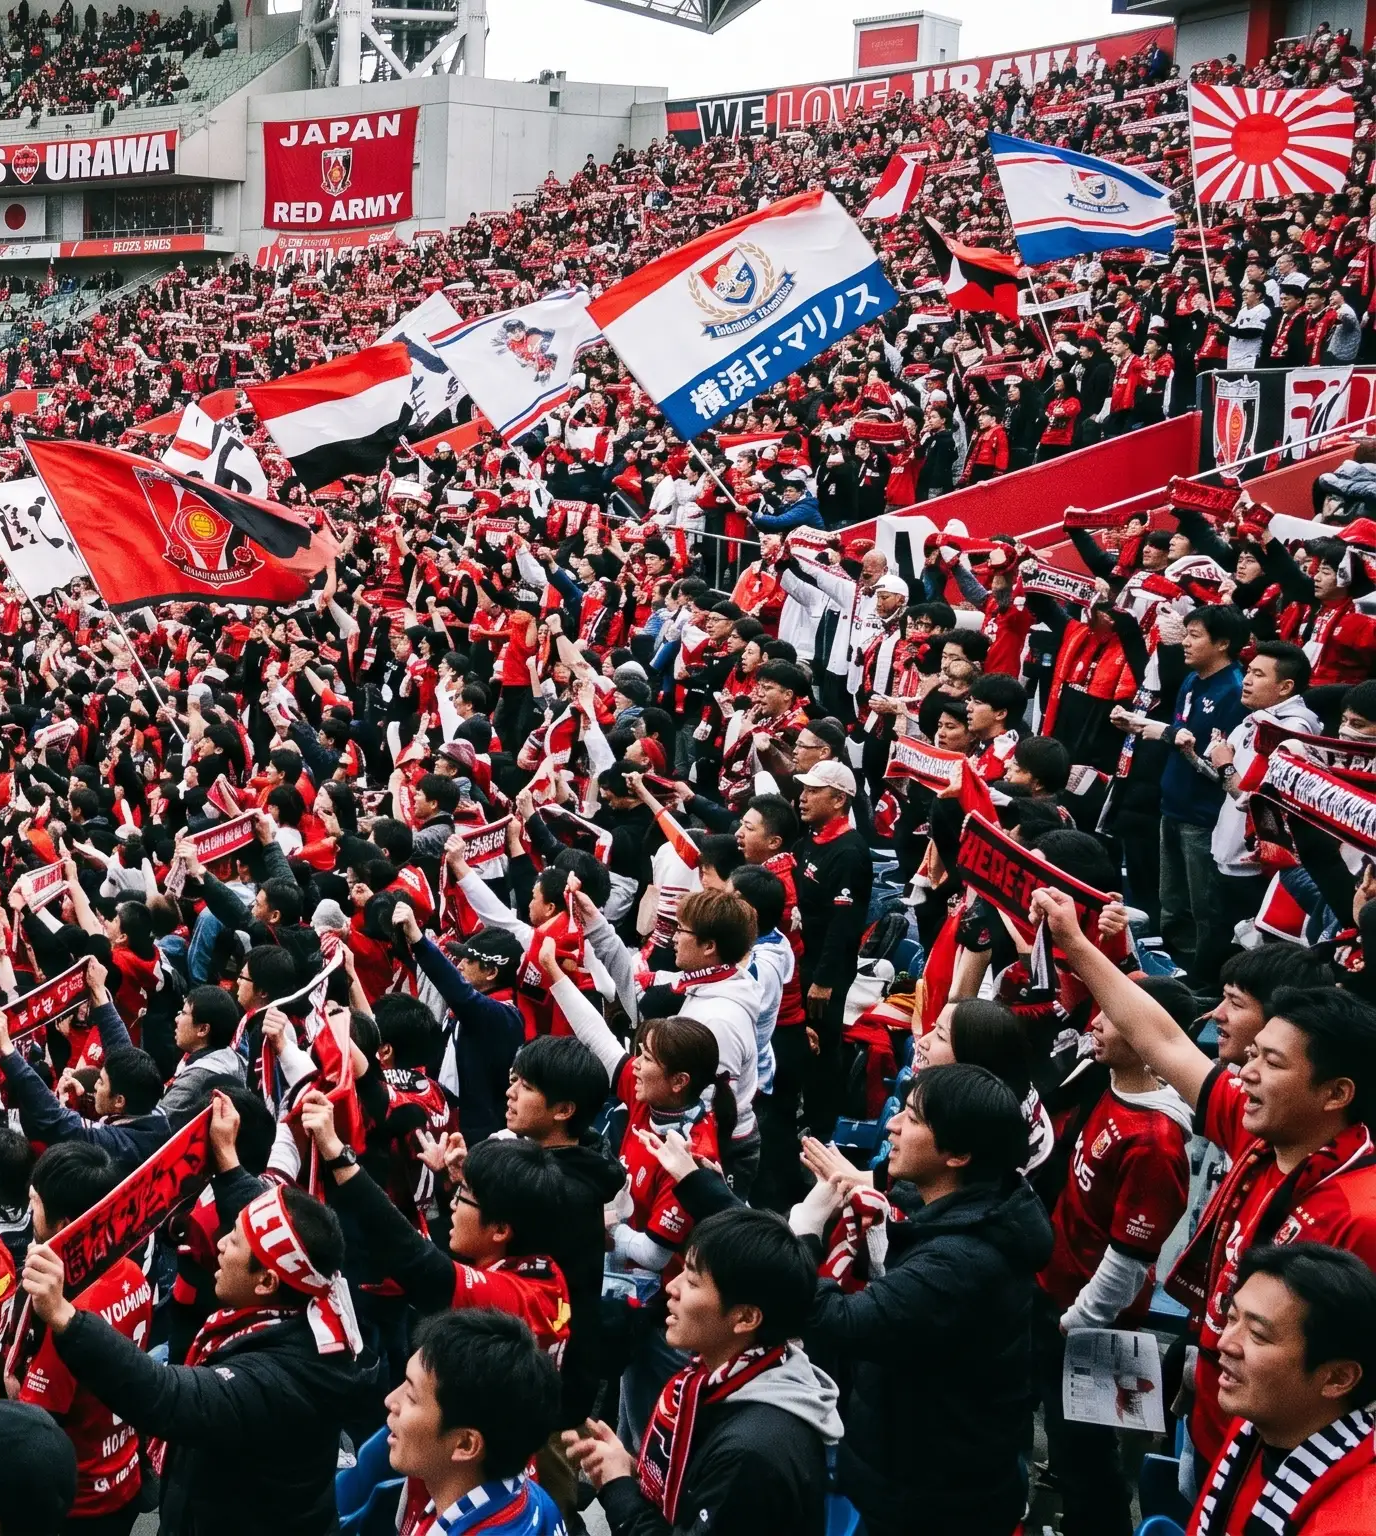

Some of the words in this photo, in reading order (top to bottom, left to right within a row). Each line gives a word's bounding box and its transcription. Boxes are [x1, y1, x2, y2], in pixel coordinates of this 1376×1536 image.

[279, 112, 401, 148] JAPAN
[45, 133, 169, 181] URAWA
[273, 201, 323, 223] RED
[329, 192, 403, 222] ARMY
